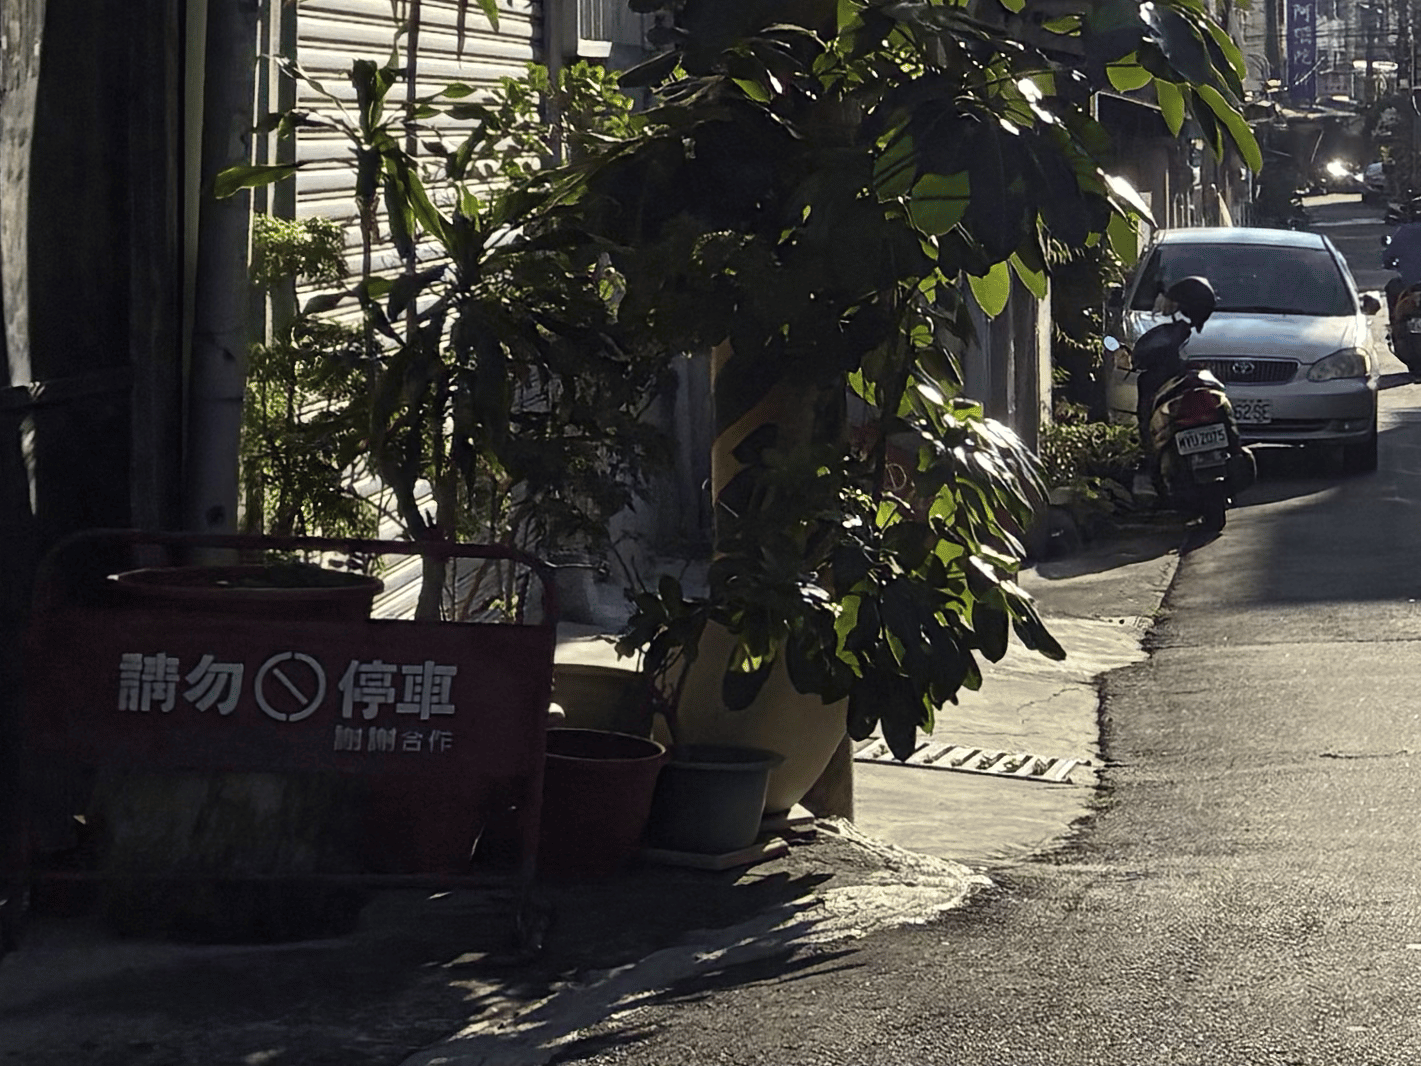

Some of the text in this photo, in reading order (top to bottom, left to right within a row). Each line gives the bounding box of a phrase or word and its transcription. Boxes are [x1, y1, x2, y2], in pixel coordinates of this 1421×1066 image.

[117, 651, 458, 720] 請勿 停車
[333, 724, 454, 752] 謝謝合作
